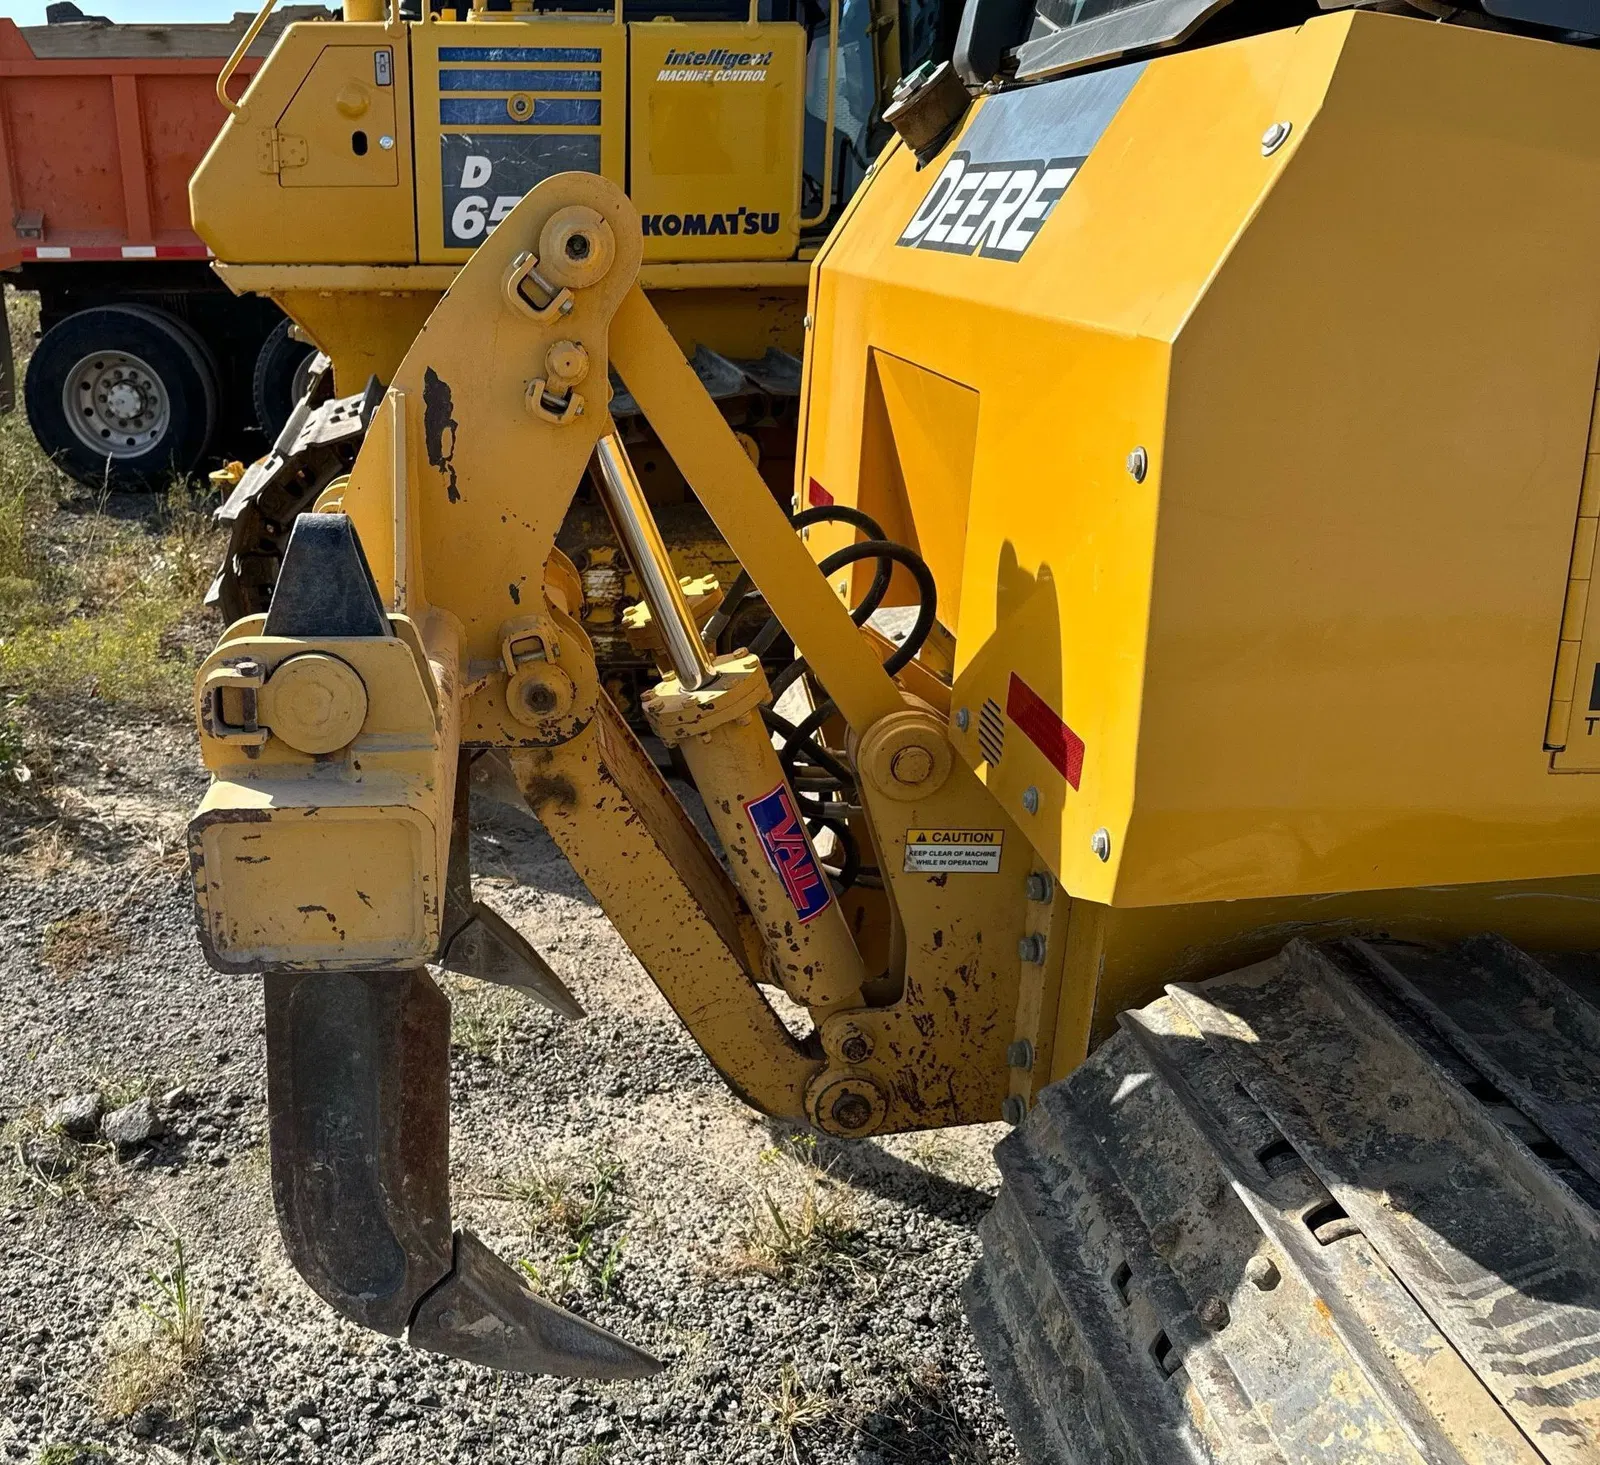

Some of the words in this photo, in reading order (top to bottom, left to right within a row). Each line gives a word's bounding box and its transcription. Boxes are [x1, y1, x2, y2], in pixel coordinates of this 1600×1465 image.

[656, 69, 713, 81] MACHINE
[714, 69, 767, 81] CONTROL
[460, 155, 492, 188] D
[901, 158, 1077, 251] DEERE
[641, 207, 780, 236] KOMATSU
[766, 794, 819, 911] VAIL
[932, 832, 994, 843] CAUTION
